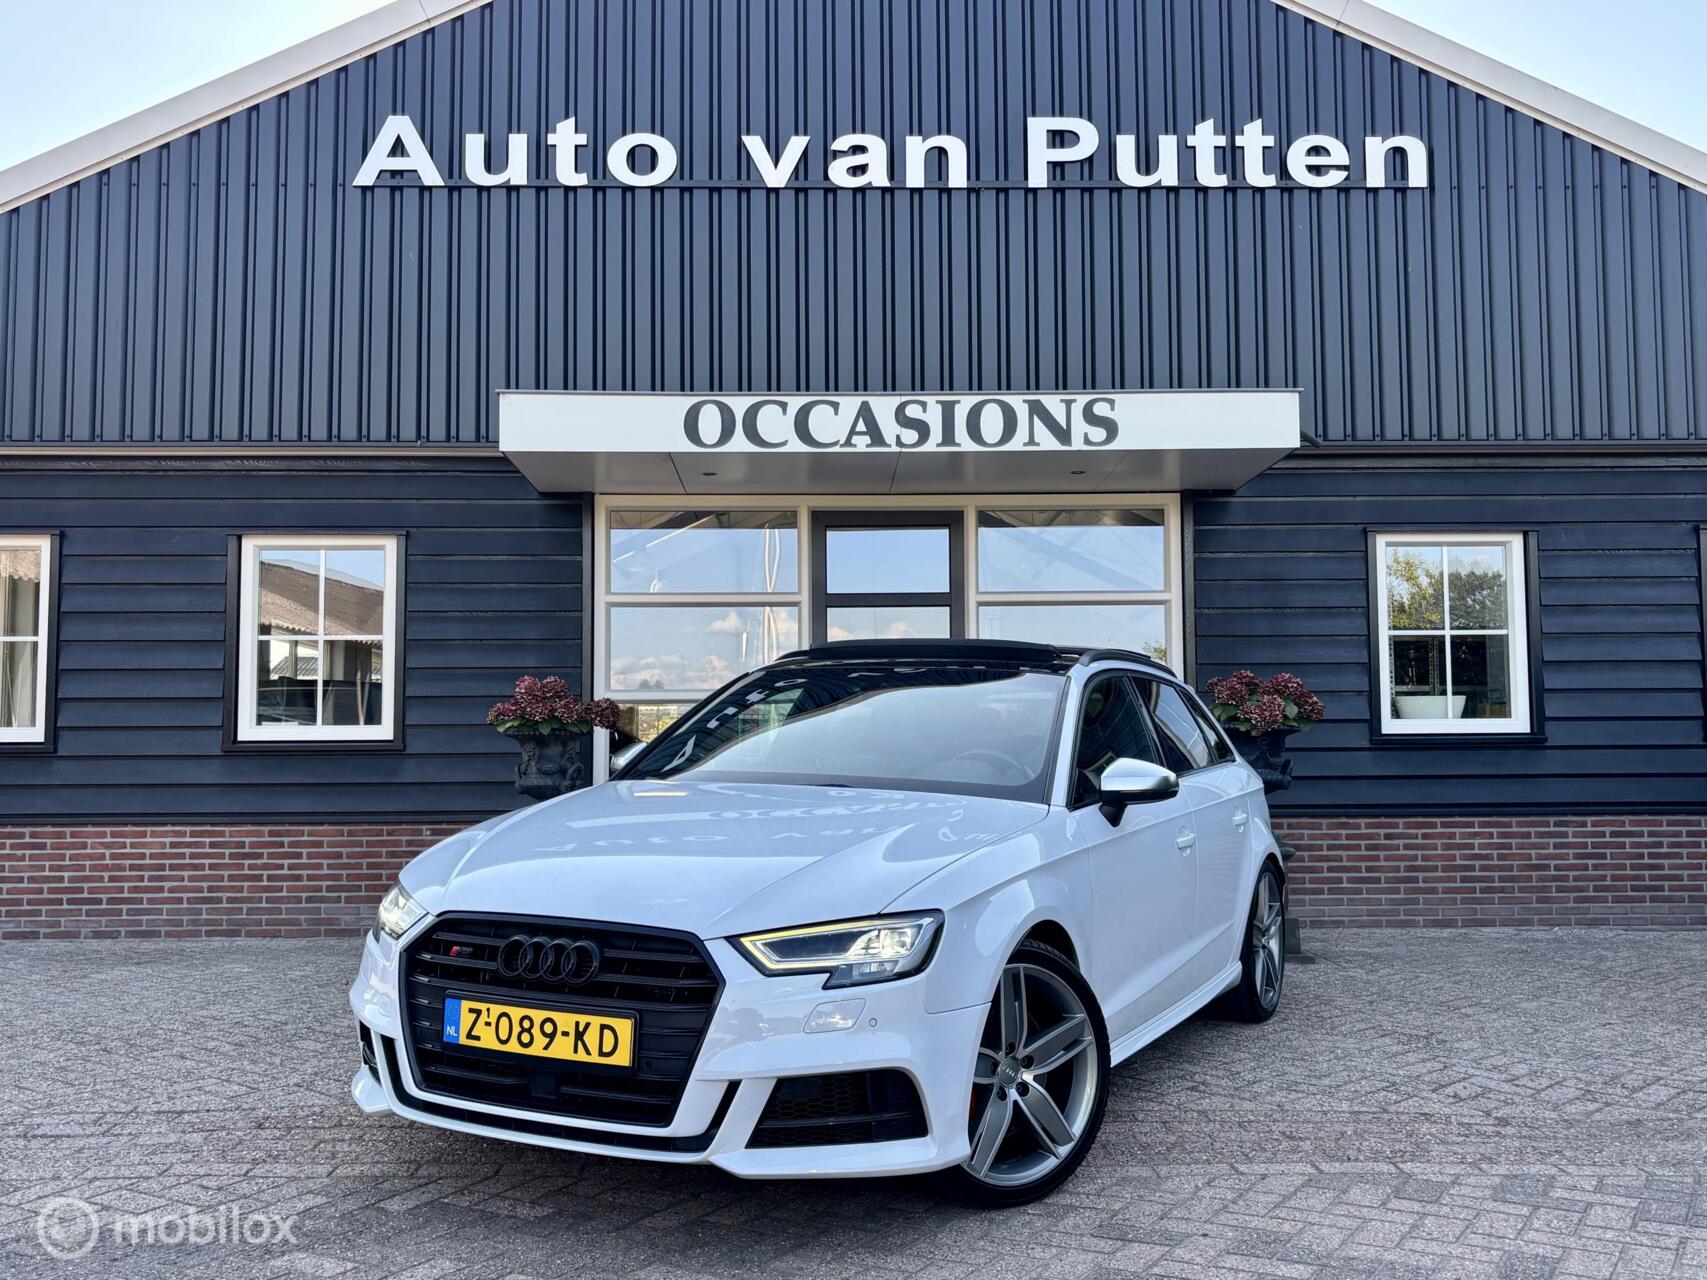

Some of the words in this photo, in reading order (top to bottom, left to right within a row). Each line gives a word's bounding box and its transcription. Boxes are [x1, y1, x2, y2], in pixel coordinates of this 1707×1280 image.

[352, 115, 677, 187] Auto
[742, 135, 967, 187] van
[1027, 117, 1427, 187] Putten
[684, 397, 1118, 449] OCCASIONS
[446, 1025, 458, 1036] NL
